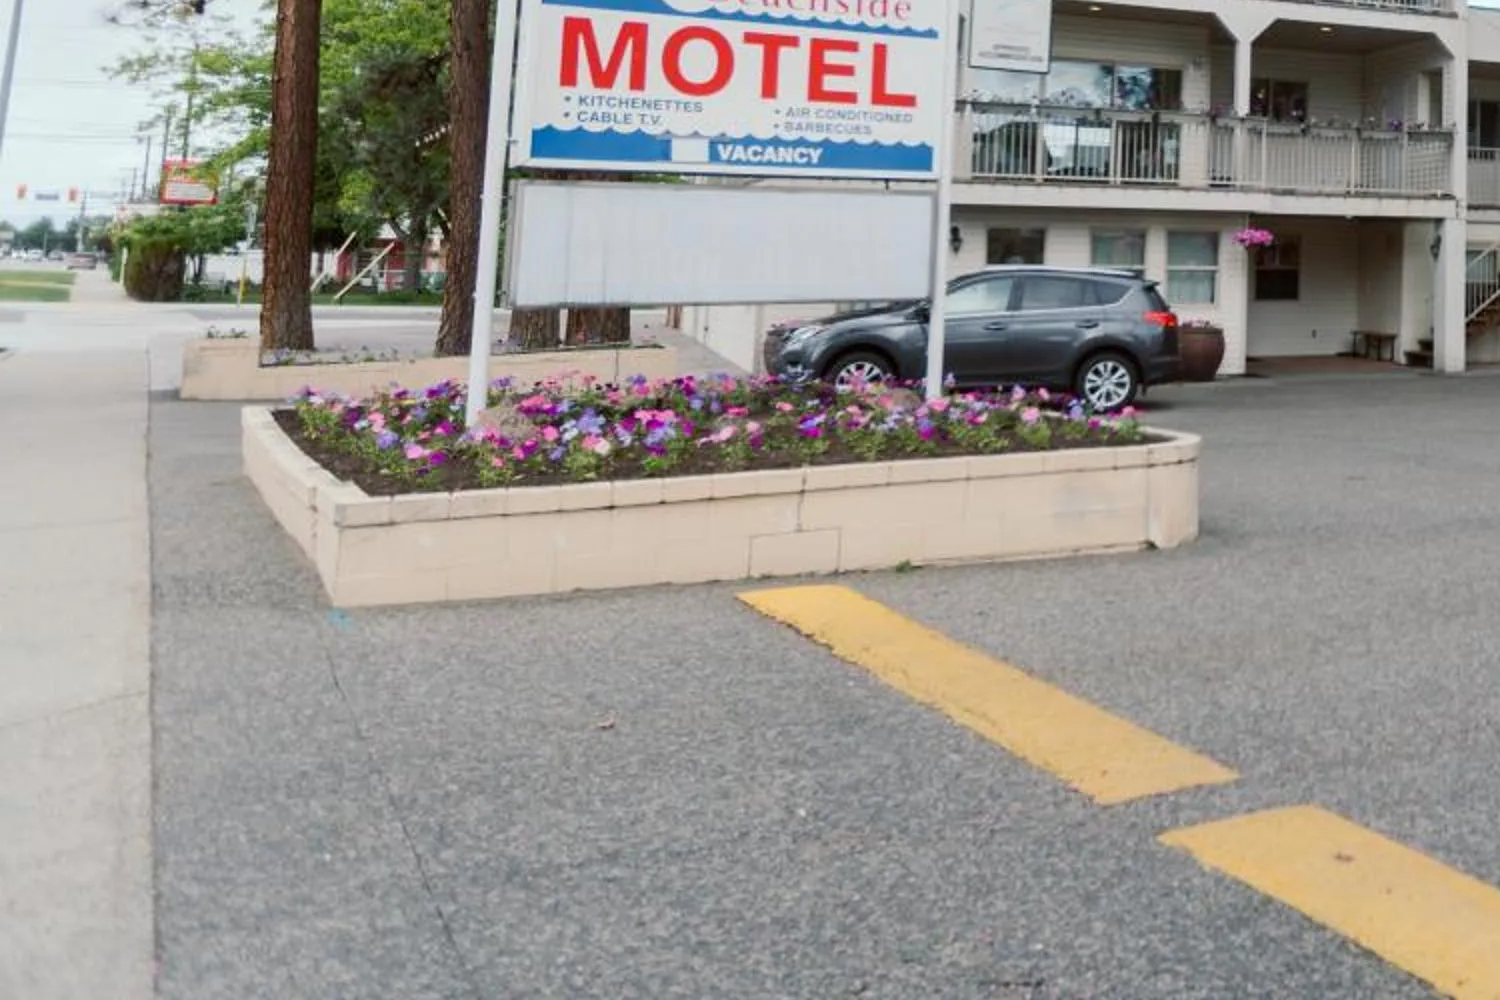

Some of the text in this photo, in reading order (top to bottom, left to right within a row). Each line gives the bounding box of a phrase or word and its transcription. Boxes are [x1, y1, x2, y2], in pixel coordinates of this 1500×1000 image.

[560, 16, 917, 107] MOTEL
[578, 95, 704, 113] KITCHENETTES
[577, 111, 633, 125] CABLE
[785, 106, 913, 124] AIR CONDITIONED
[784, 121, 873, 136] BARBECUES
[717, 143, 824, 165] VACANCY
